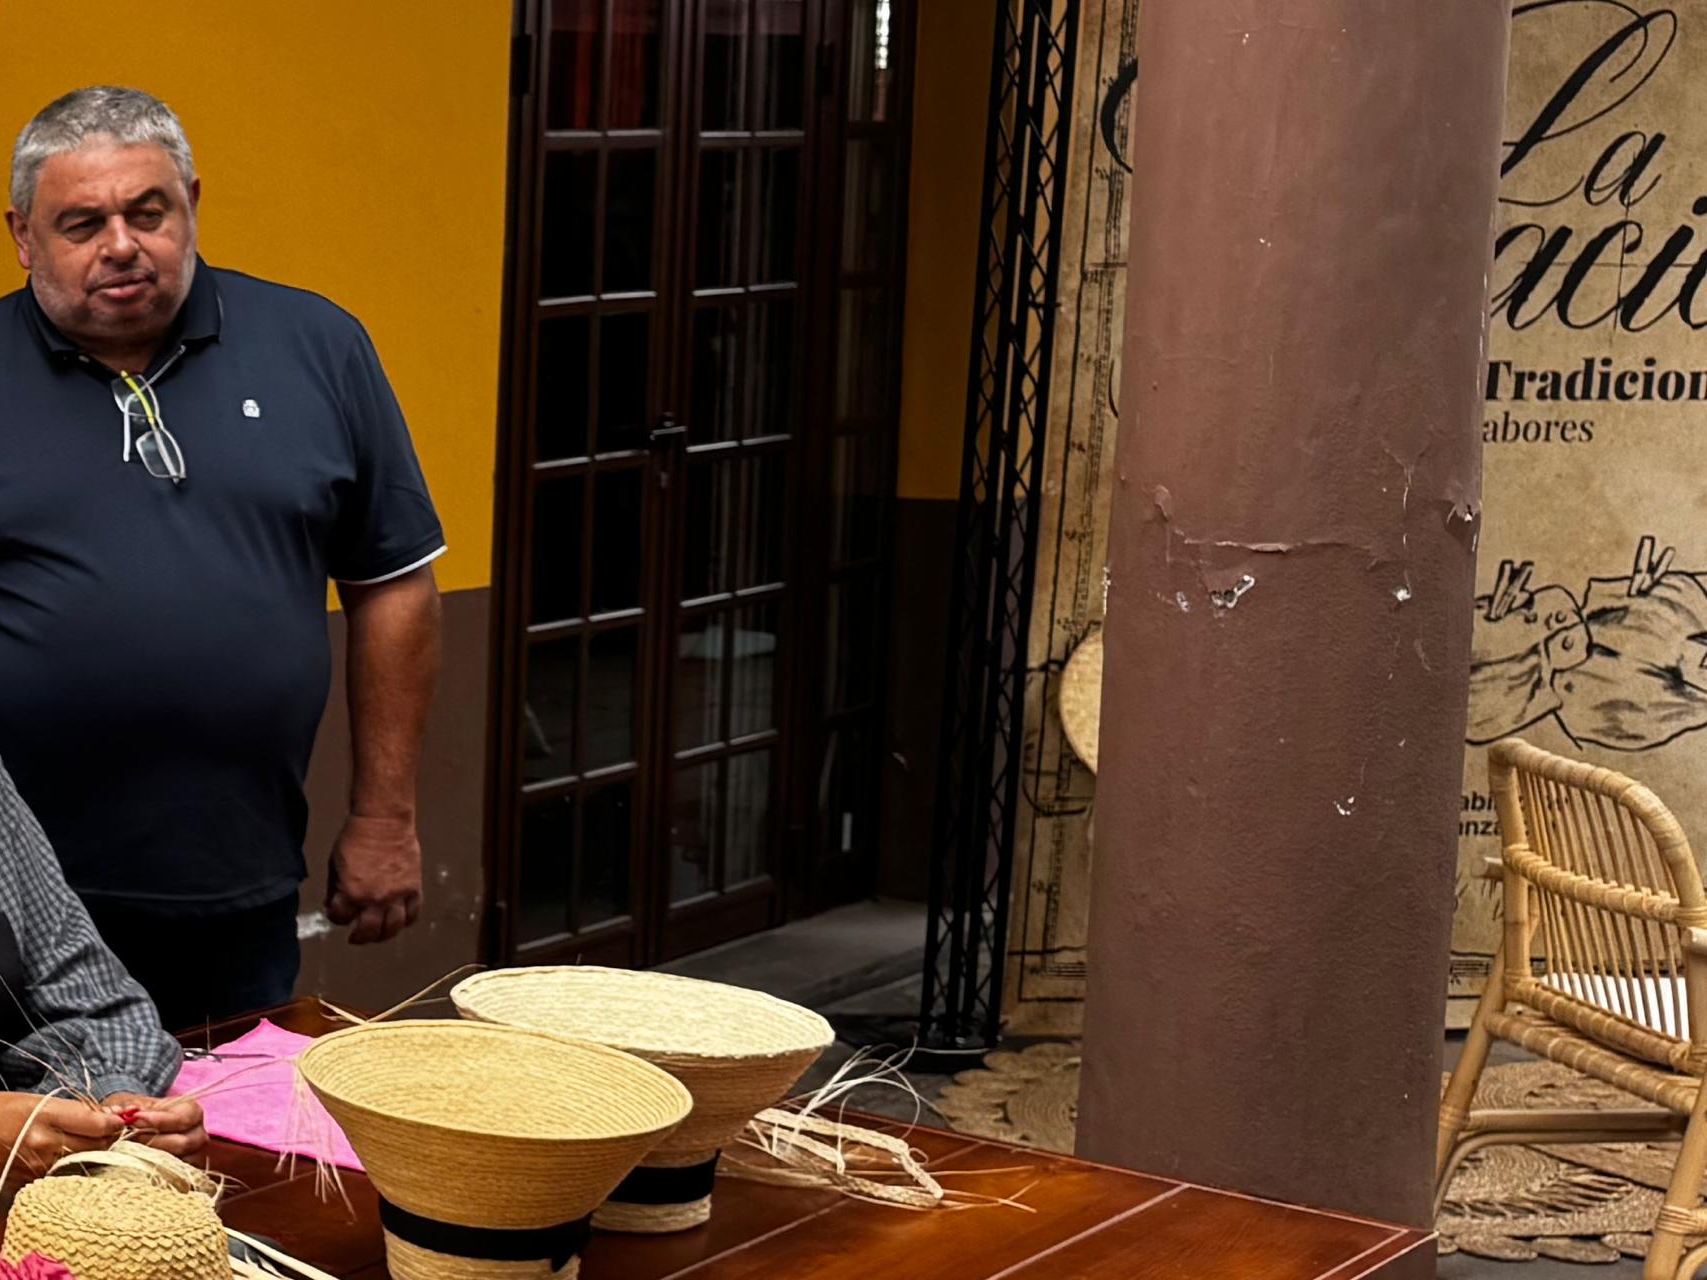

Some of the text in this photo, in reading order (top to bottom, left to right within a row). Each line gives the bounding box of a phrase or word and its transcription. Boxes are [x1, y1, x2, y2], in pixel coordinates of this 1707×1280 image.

[1491, 197, 1707, 332] aci
[1485, 357, 1707, 401] Tradicion
[1483, 411, 1594, 443] abores
